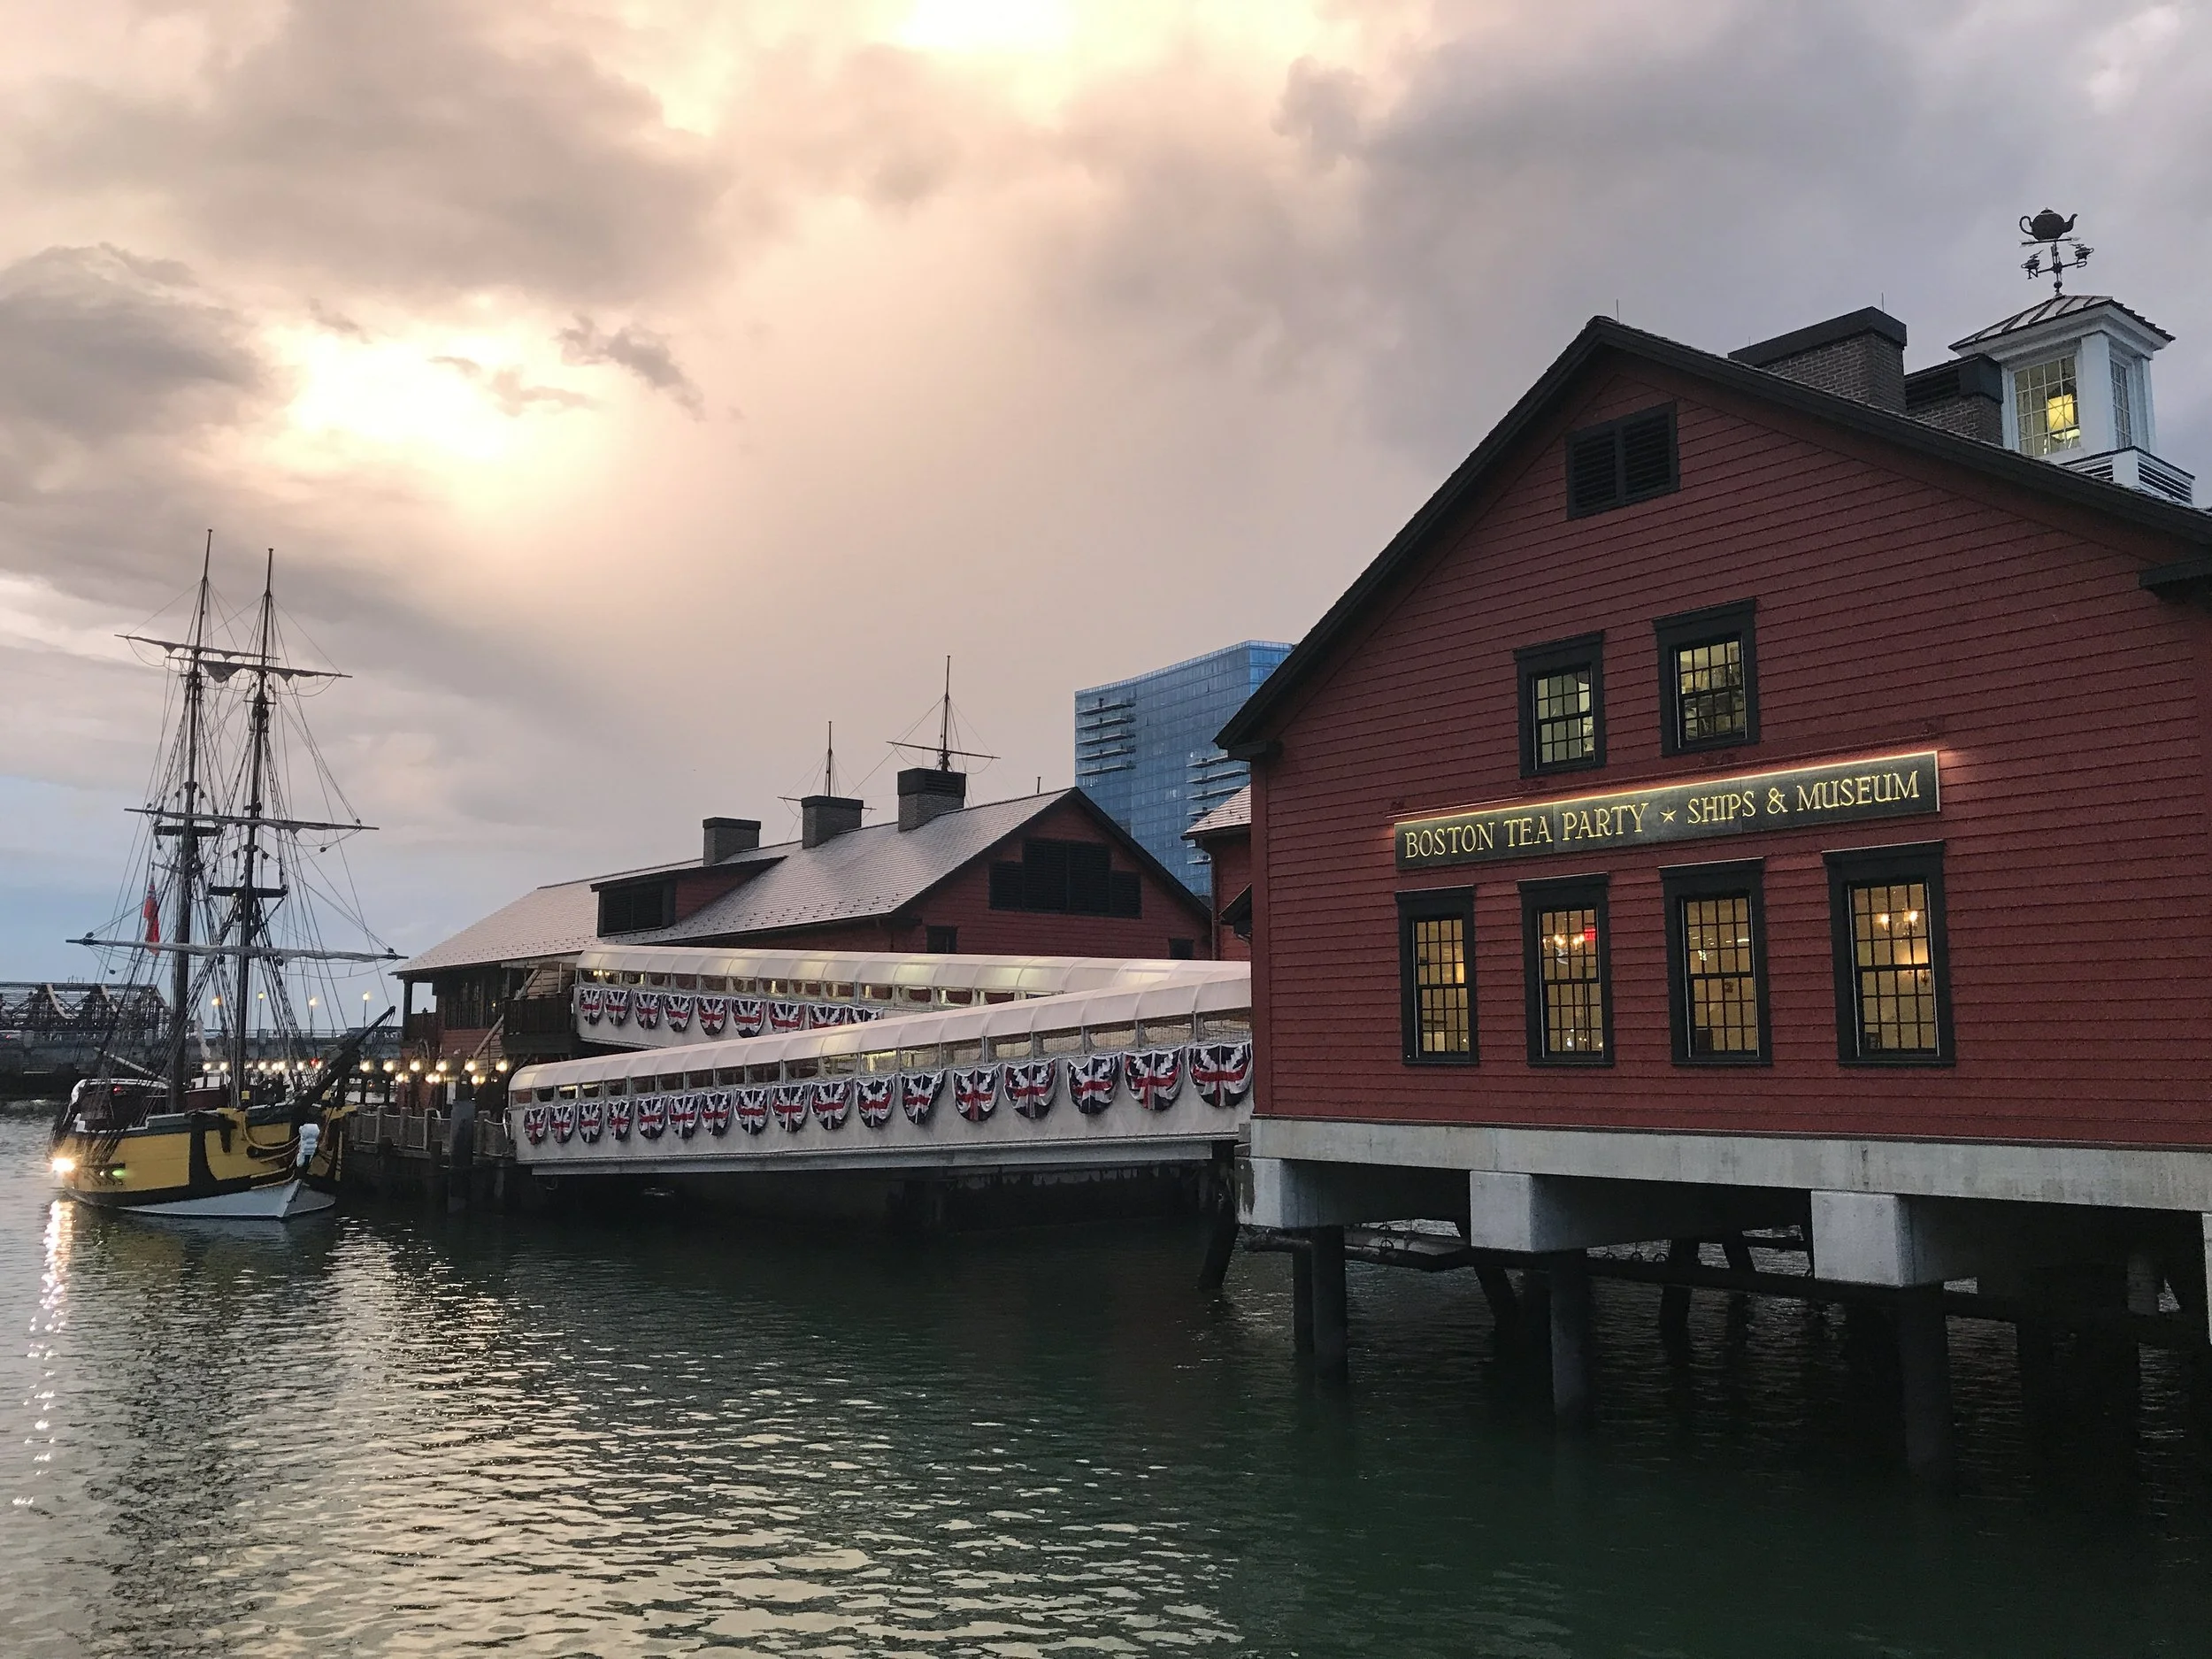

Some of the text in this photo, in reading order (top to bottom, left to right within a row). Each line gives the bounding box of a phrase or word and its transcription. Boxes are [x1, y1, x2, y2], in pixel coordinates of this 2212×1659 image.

[1405, 770, 1920, 858] BOSTON TEA PARTY SHIPS & MUSEUM
